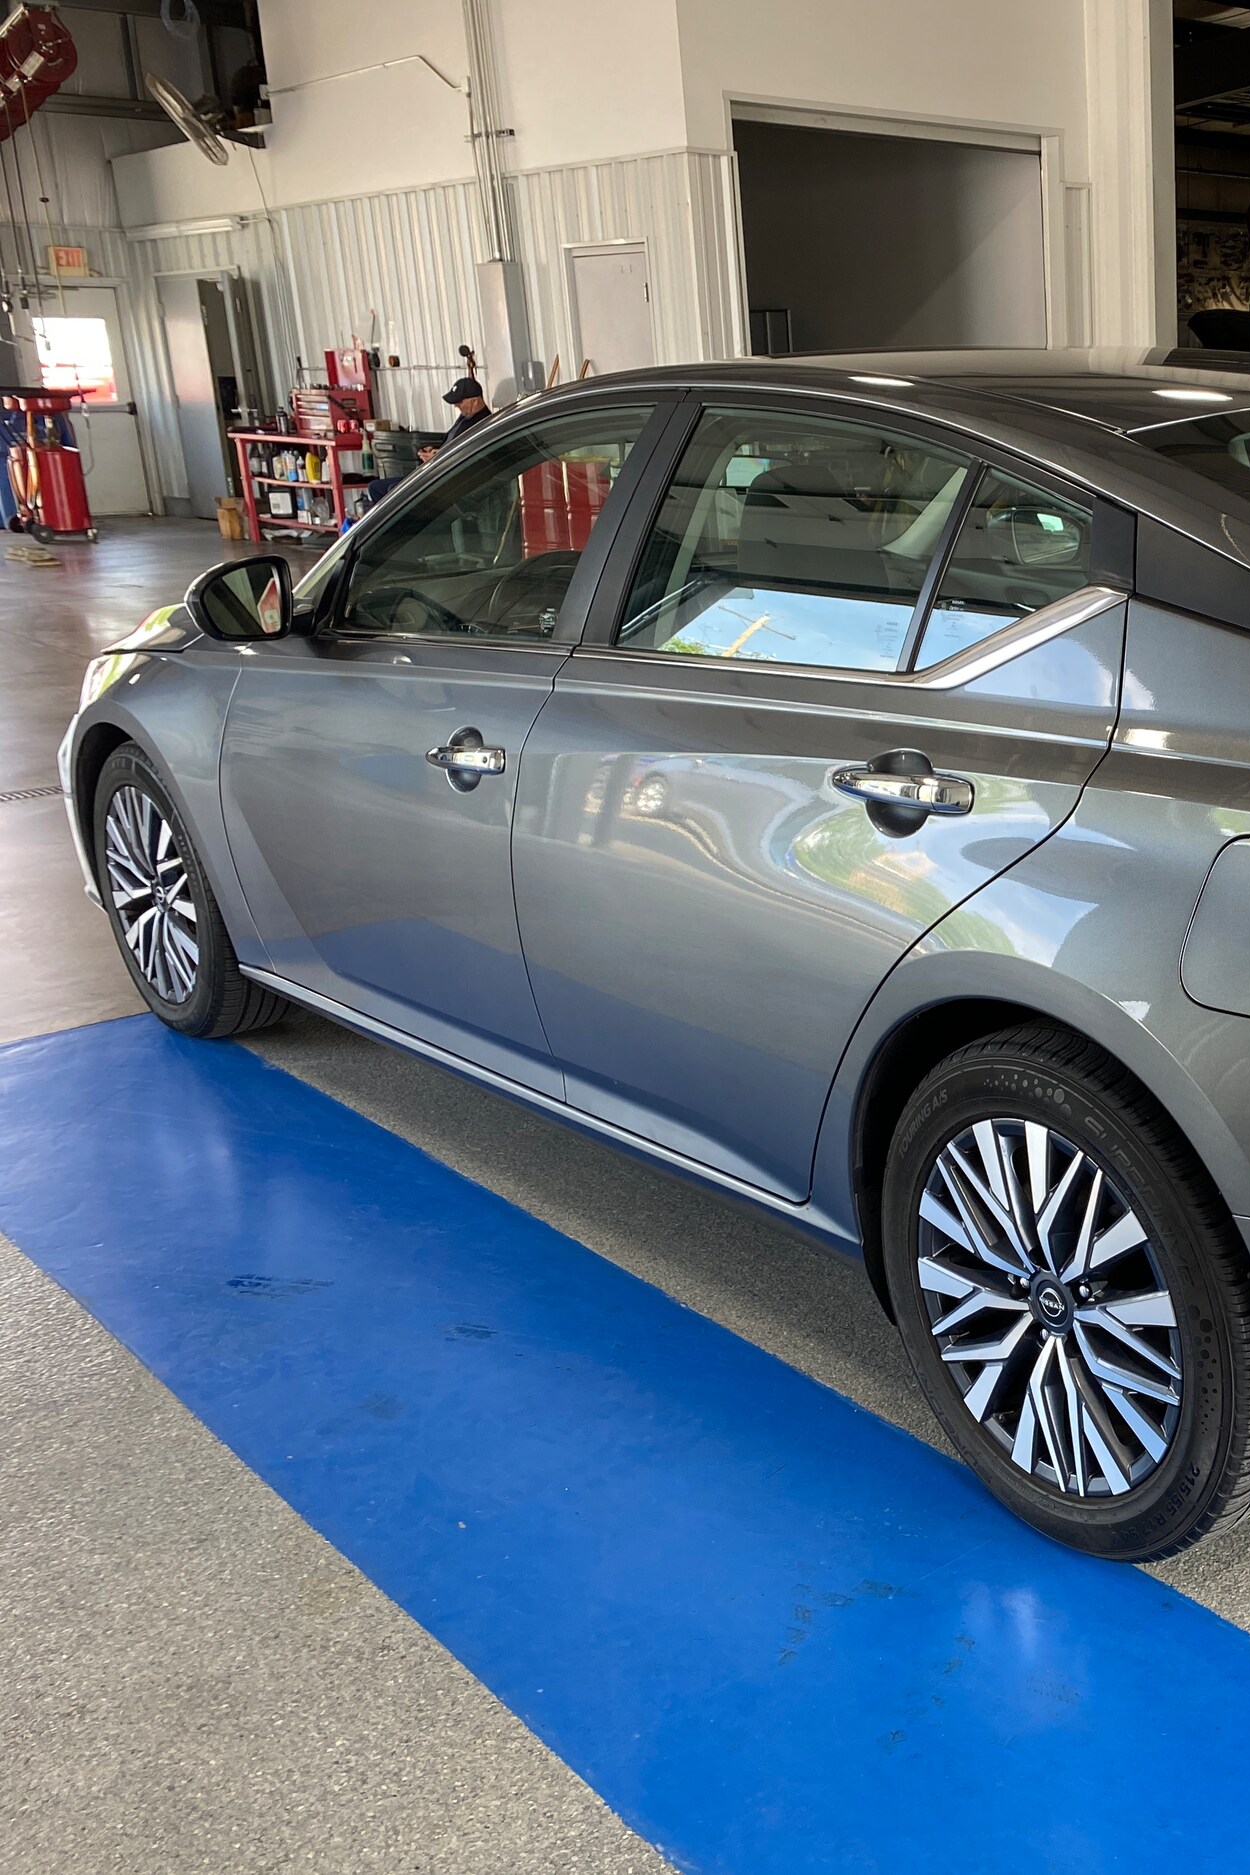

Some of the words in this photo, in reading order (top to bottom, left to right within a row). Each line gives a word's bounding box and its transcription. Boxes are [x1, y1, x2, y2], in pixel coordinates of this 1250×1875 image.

[899, 1102, 932, 1159] TOURING
[930, 1088, 949, 1112] A/S
[1169, 1461, 1201, 1517] 215/55
